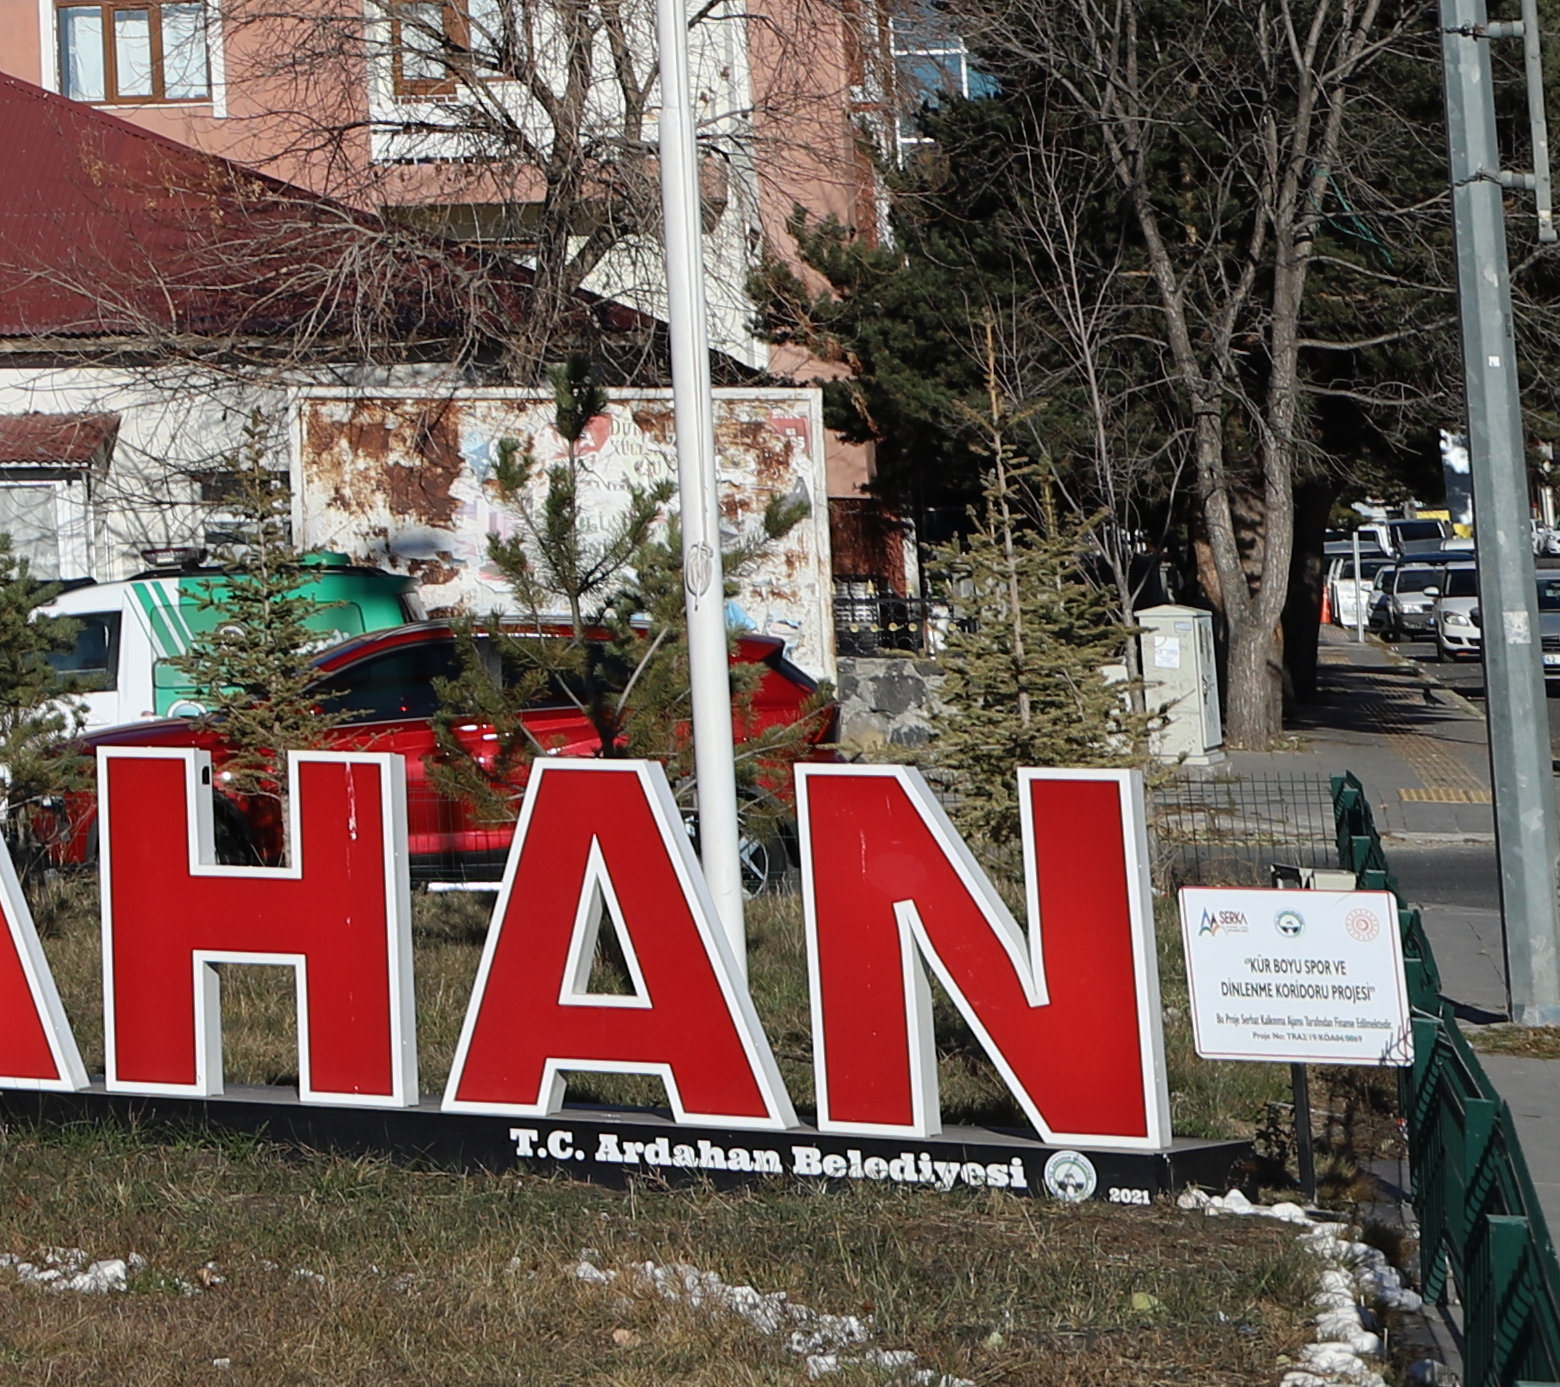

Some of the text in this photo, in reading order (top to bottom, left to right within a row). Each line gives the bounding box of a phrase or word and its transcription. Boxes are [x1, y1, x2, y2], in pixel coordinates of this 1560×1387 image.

[1219, 910, 1248, 925] SERKA
[1273, 958, 1302, 974] BOYU
[1305, 960, 1332, 975] SPOR
[1332, 960, 1347, 976] VE
[1221, 978, 1273, 998] DİNLENME
[1275, 979, 1329, 1000] KORİDORU
[510, 1128, 585, 1161] T.C.
[595, 1133, 783, 1174] Ardahan
[791, 1145, 1028, 1192] Belediyesi
[1109, 1187, 1151, 1205] 2021
